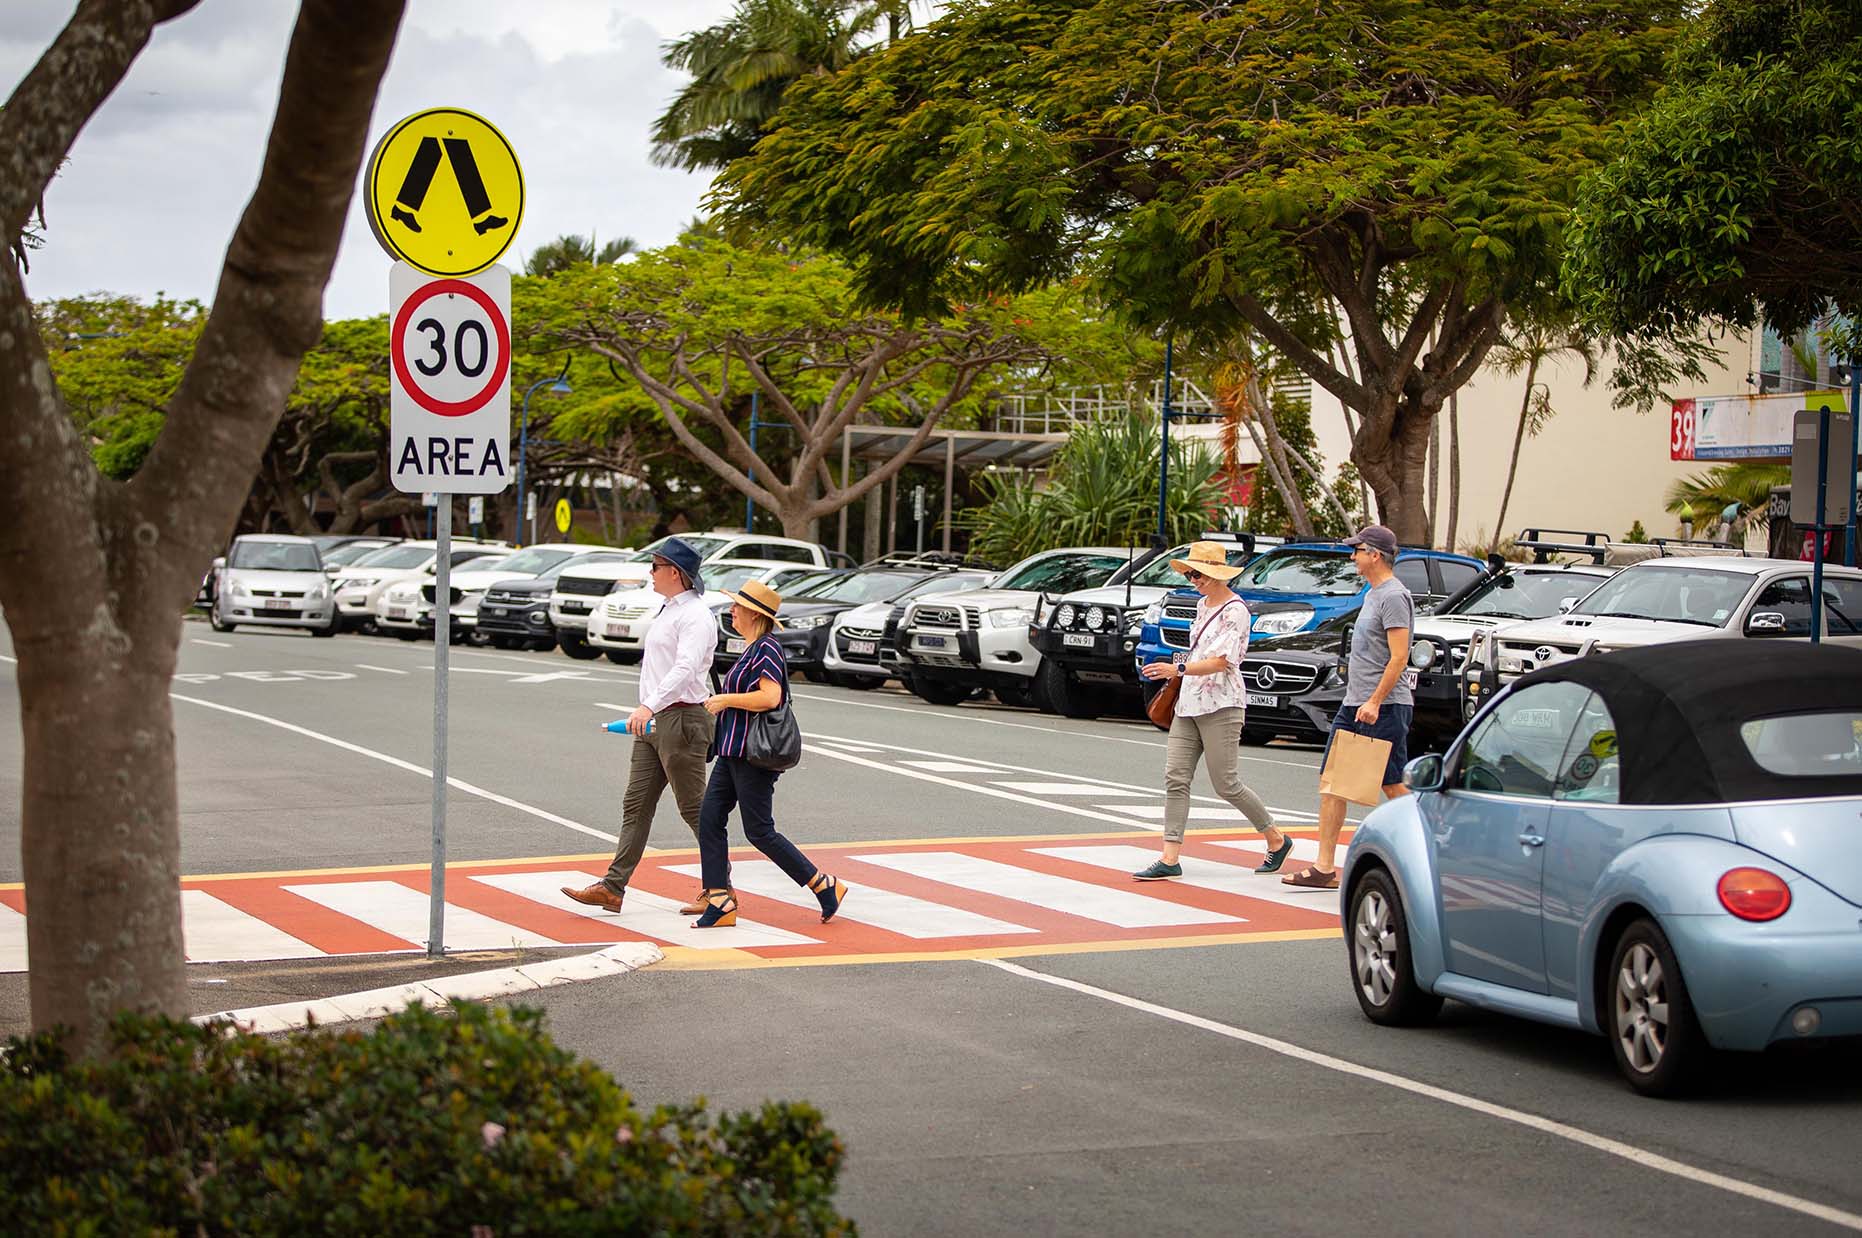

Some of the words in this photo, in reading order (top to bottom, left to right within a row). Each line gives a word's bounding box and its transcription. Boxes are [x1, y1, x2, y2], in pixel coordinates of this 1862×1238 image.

[414, 318, 489, 378] 30
[1672, 411, 1694, 452] 39
[397, 437, 505, 476] AREA
